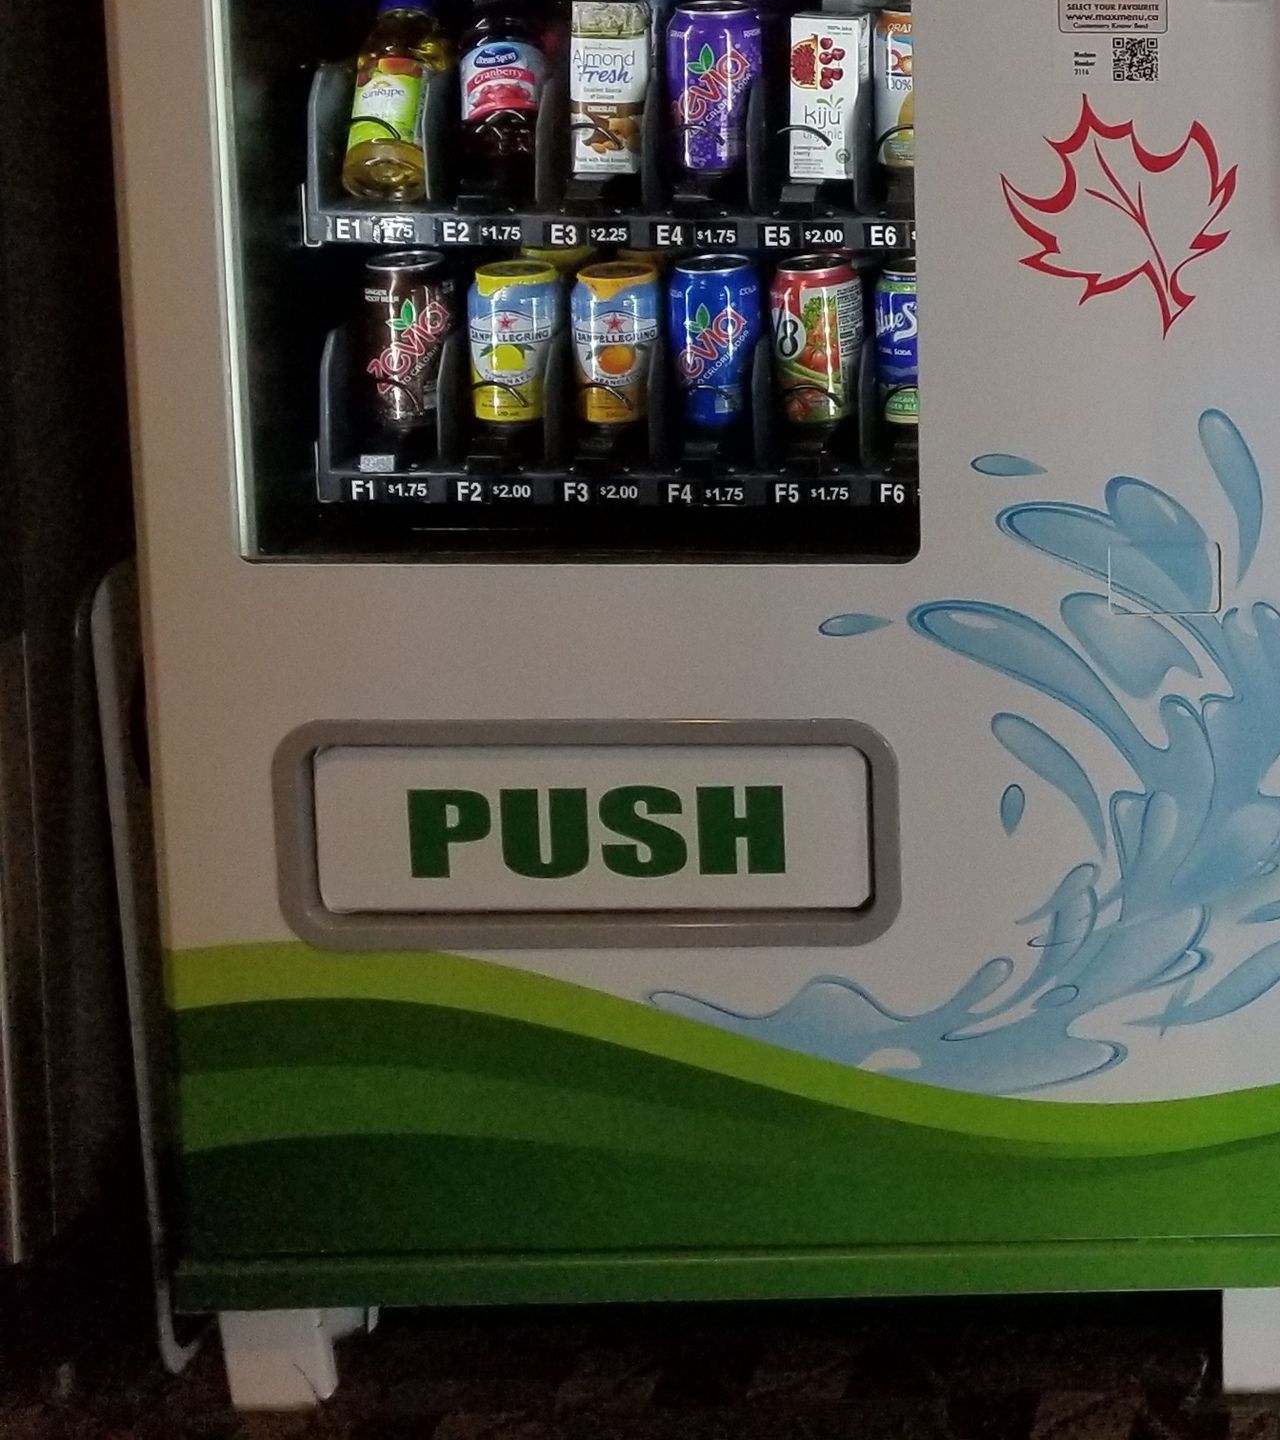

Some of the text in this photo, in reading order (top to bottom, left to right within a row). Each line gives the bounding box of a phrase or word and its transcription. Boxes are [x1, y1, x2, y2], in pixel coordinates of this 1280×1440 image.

[1066, 13, 1159, 21] www.maxmenu.ca
[573, 49, 634, 68] Almond
[473, 69, 523, 86] Cranberry
[582, 65, 633, 84] Fresh
[804, 103, 841, 130] kiju
[336, 218, 361, 240] E1
[444, 221, 469, 242] E2
[482, 223, 521, 241] $1.75
[551, 224, 577, 245] E3
[590, 226, 627, 242] $2.25
[657, 224, 683, 245] E4
[697, 227, 736, 243] $1.75
[765, 226, 790, 246] E5
[805, 228, 844, 243] $2.00
[871, 225, 896, 245] E6
[351, 481, 376, 501] F1
[388, 482, 427, 498] $1.75
[457, 483, 482, 503] F2
[492, 484, 531, 500] $2.00
[564, 483, 589, 503] F3
[600, 485, 638, 500] $2.00
[668, 484, 692, 504] F4
[705, 486, 743, 501] $1.75
[775, 484, 799, 504] F5
[810, 486, 848, 501] $1.75
[880, 483, 905, 503] F6
[406, 784, 786, 879] PUSH
